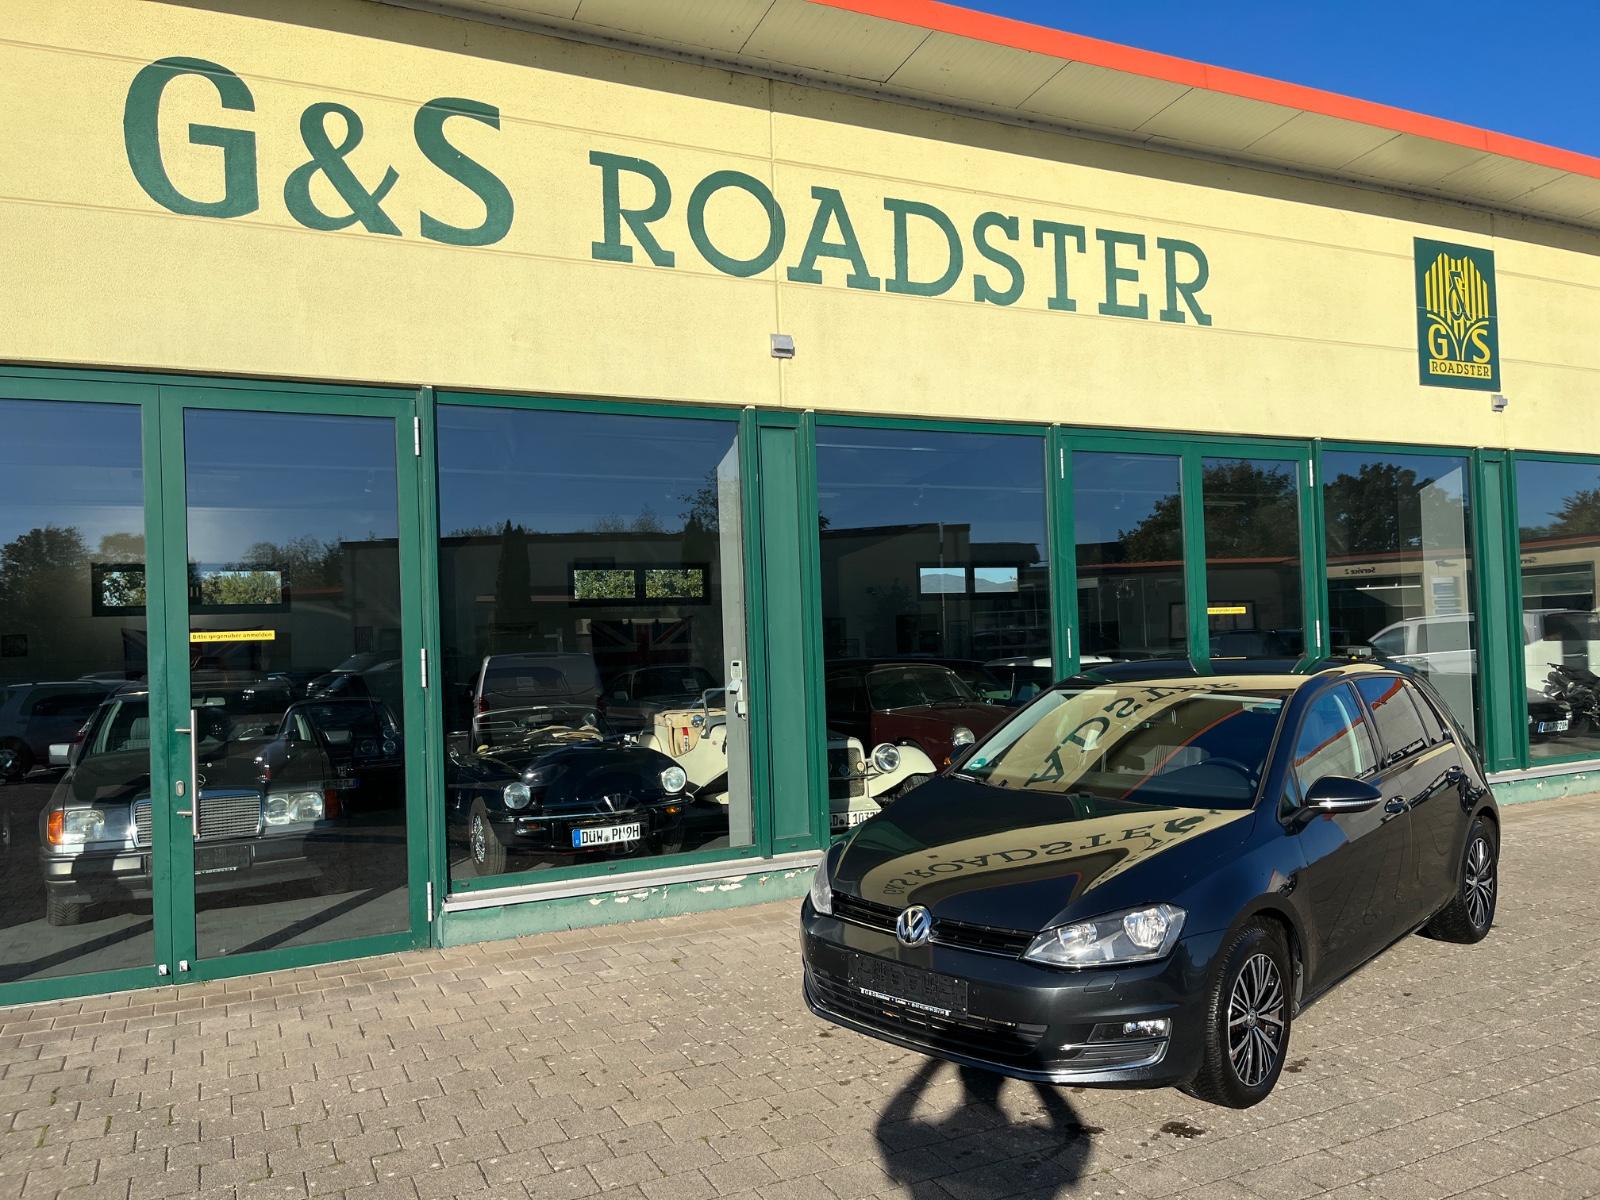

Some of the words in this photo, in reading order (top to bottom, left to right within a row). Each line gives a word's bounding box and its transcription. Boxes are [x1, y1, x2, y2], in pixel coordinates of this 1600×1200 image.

[123, 55, 515, 247] G&S
[588, 149, 1213, 327] ROADSTER
[1428, 324, 1448, 360] G
[1471, 328, 1490, 364] S
[1431, 361, 1490, 377] ROADSTER
[582, 830, 603, 844] DÜW
